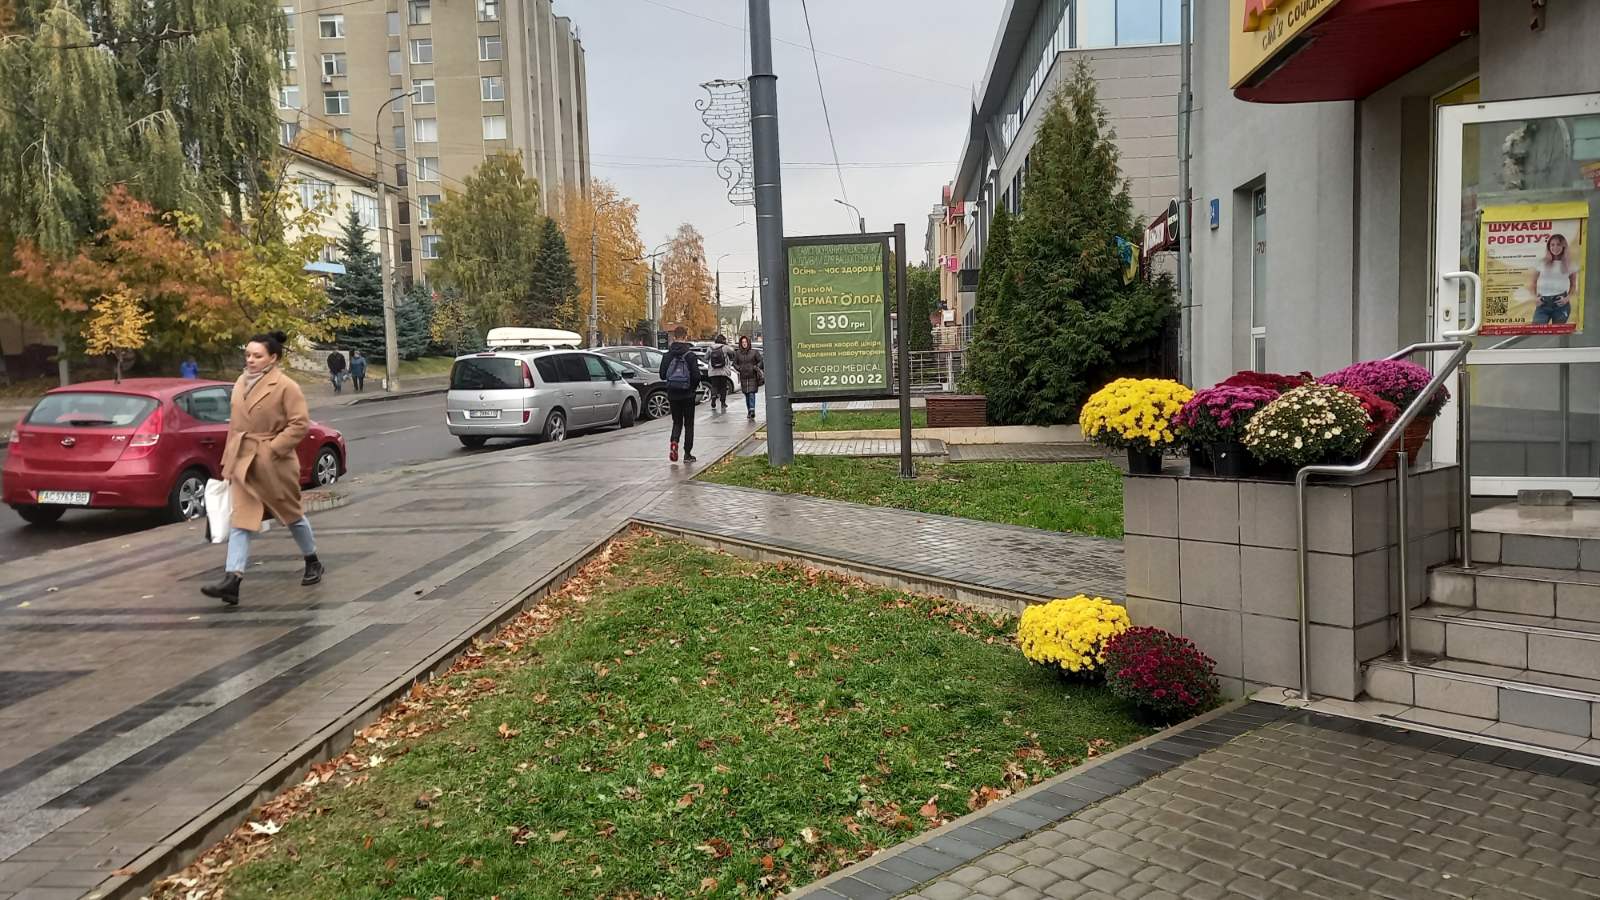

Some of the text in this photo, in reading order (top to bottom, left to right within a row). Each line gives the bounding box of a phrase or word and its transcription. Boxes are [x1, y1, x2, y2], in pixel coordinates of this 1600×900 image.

[1488, 221, 1552, 232] ШУКАЄШ
[1488, 234, 1551, 244] РОБОТУ?
[792, 266, 817, 275] Осінь
[794, 285, 833, 295] Прийом
[793, 293, 883, 307] ДЕРМАТОЛОГА
[816, 315, 865, 330] 330 грн
[799, 363, 883, 374] OXFORD MEDICAL
[822, 375, 838, 385] 22
[840, 374, 864, 385] 000
[867, 373, 883, 384] 22
